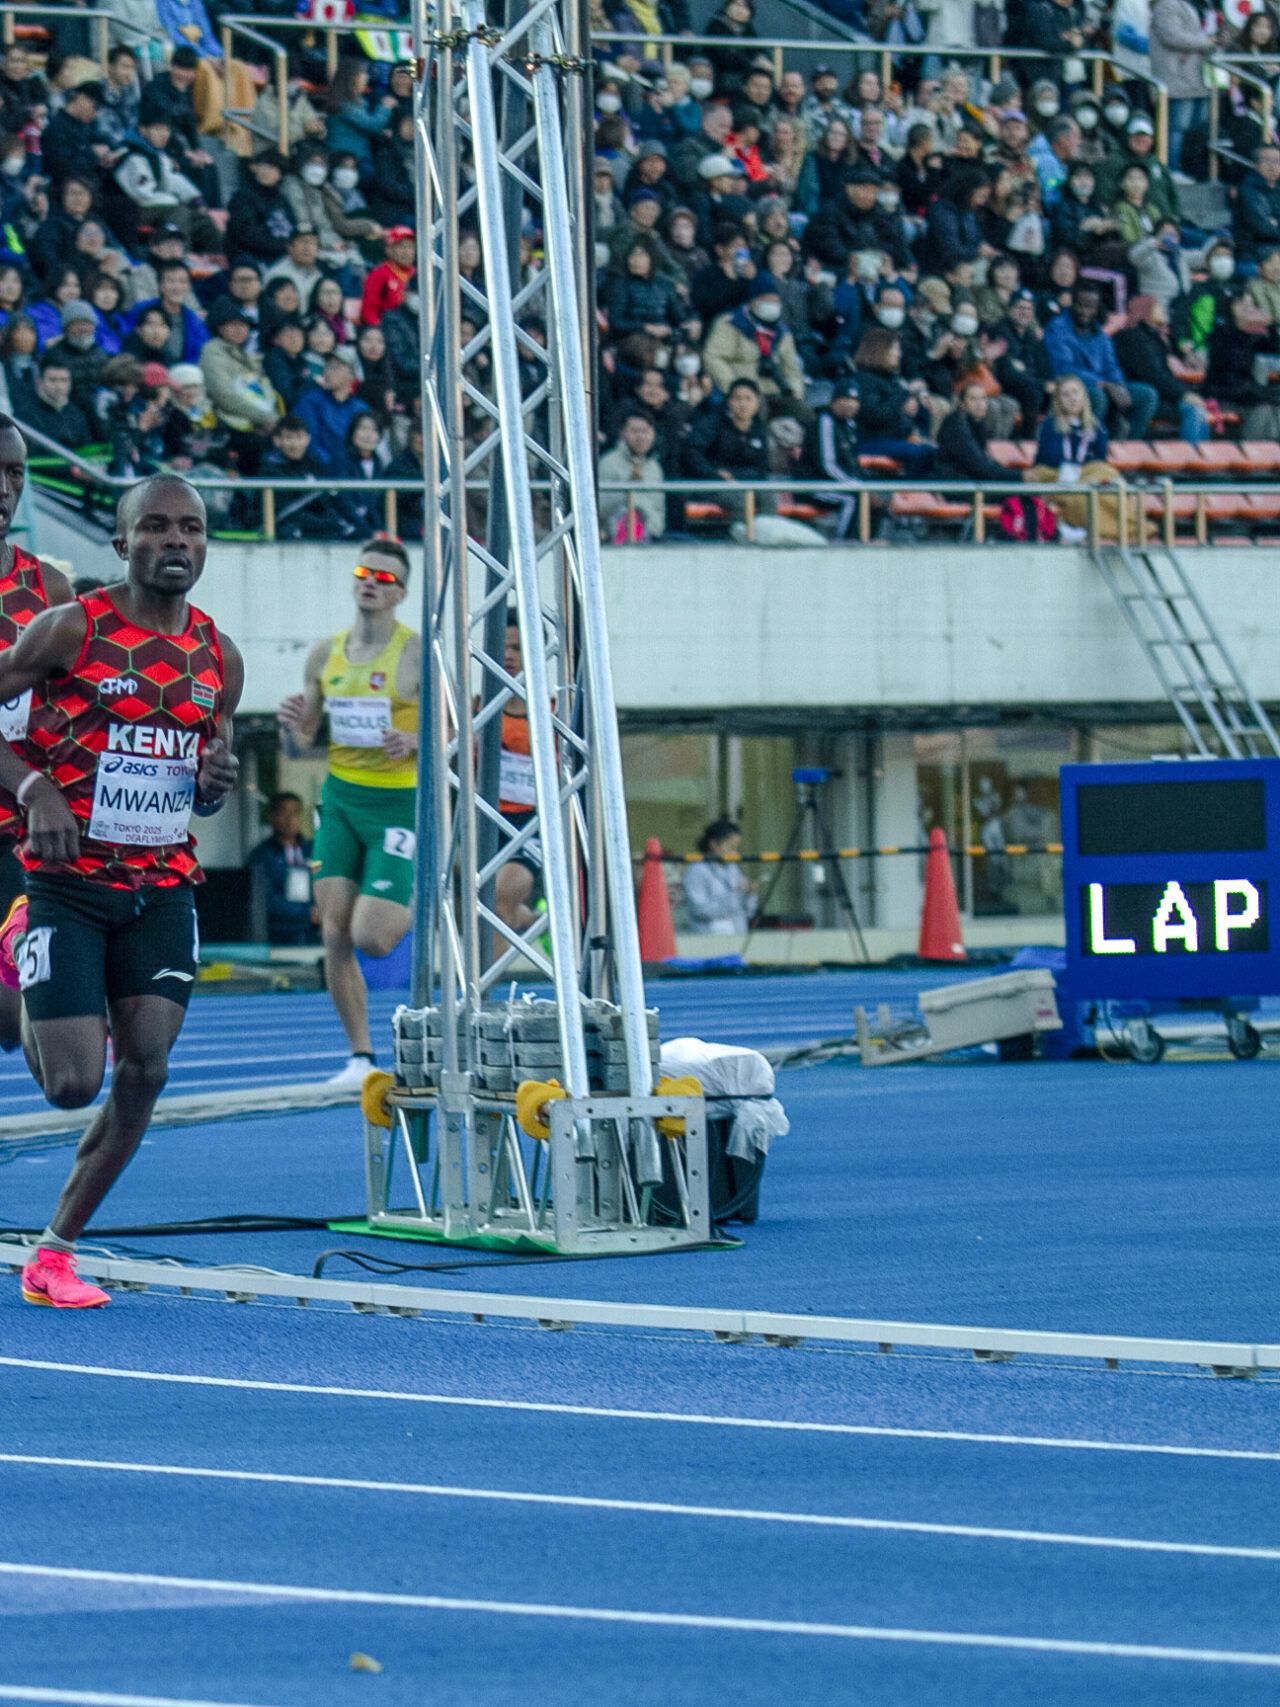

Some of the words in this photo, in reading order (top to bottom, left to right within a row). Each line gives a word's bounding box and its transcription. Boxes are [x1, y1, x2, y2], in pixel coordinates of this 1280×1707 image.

[107, 722, 201, 759] KENYA
[100, 784, 192, 815] MWANZA
[113, 822, 142, 834] TOKYO
[1089, 878, 1261, 954] LAP
